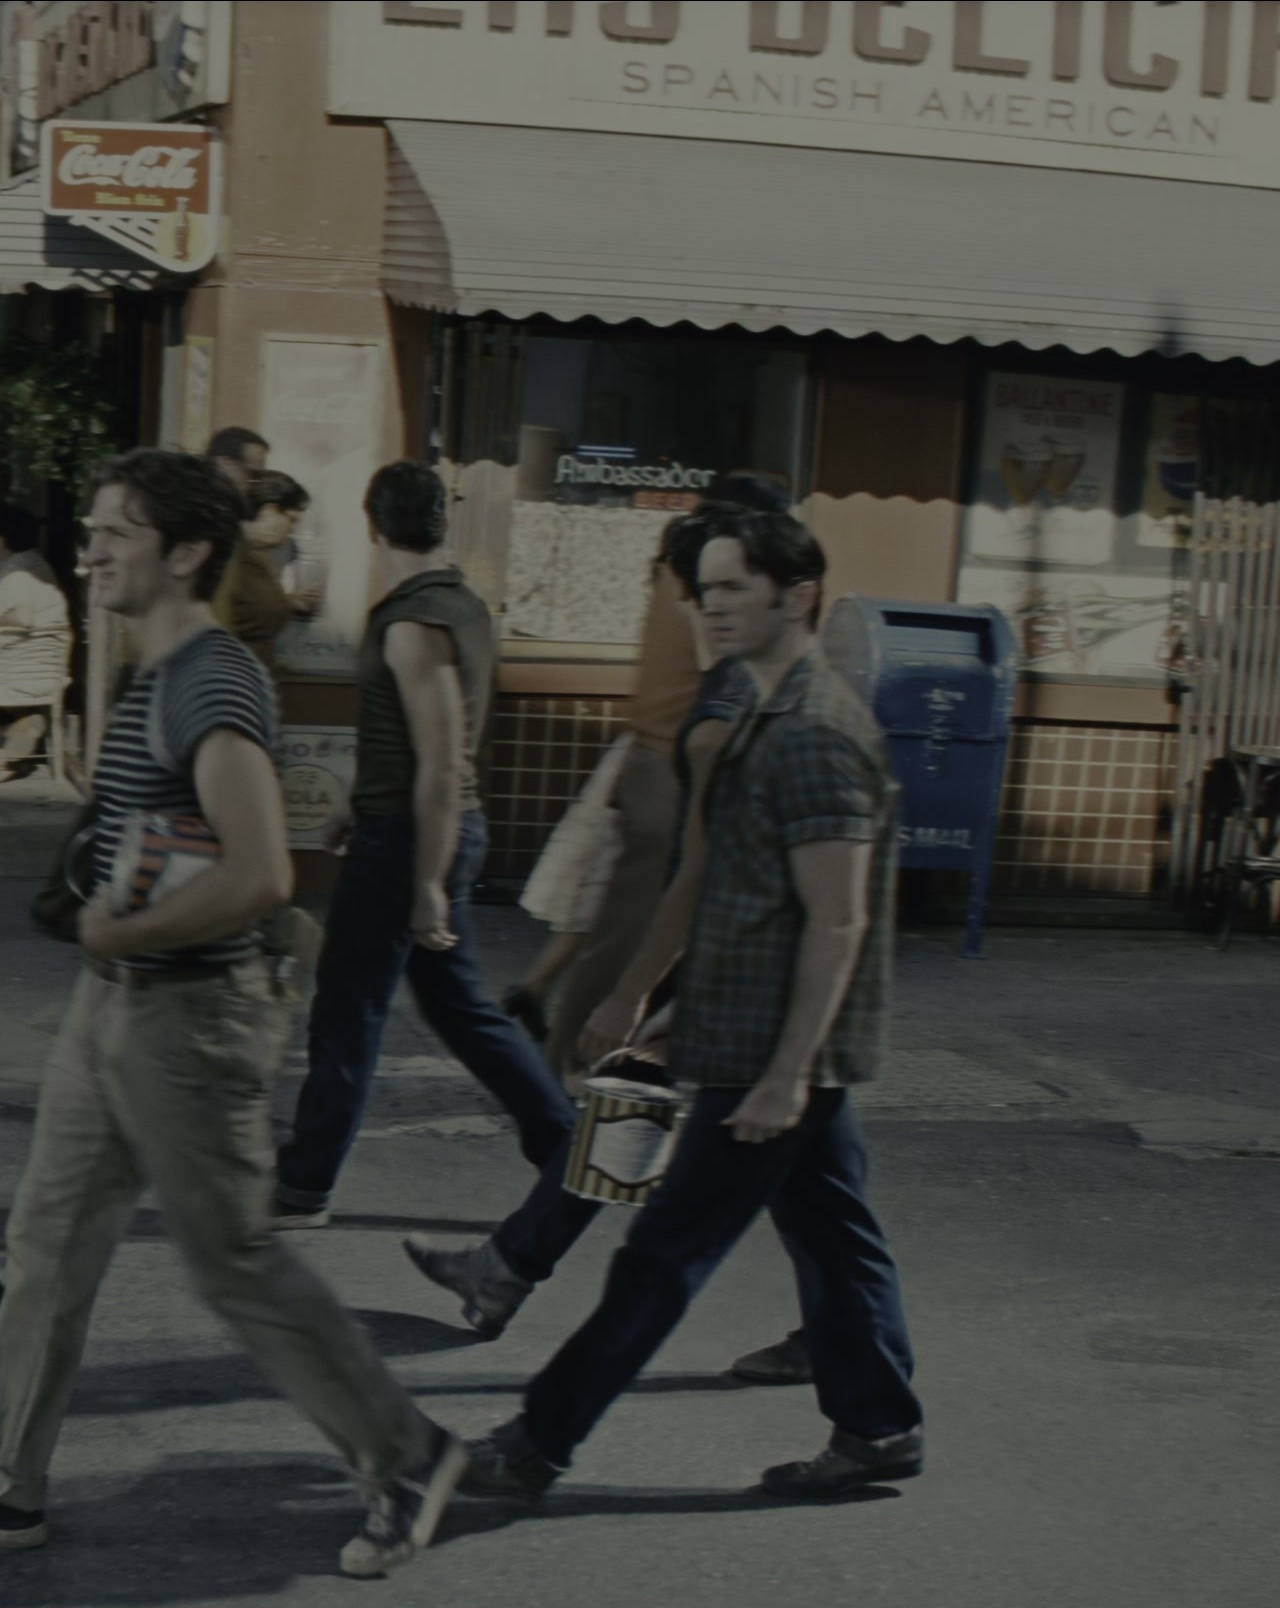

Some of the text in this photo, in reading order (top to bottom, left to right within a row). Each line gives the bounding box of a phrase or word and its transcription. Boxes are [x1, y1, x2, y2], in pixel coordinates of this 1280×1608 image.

[621, 60, 1221, 145] SPANISH AMERICAN
[58, 143, 204, 189] Coca-Cola
[554, 454, 718, 489] Ambassador
